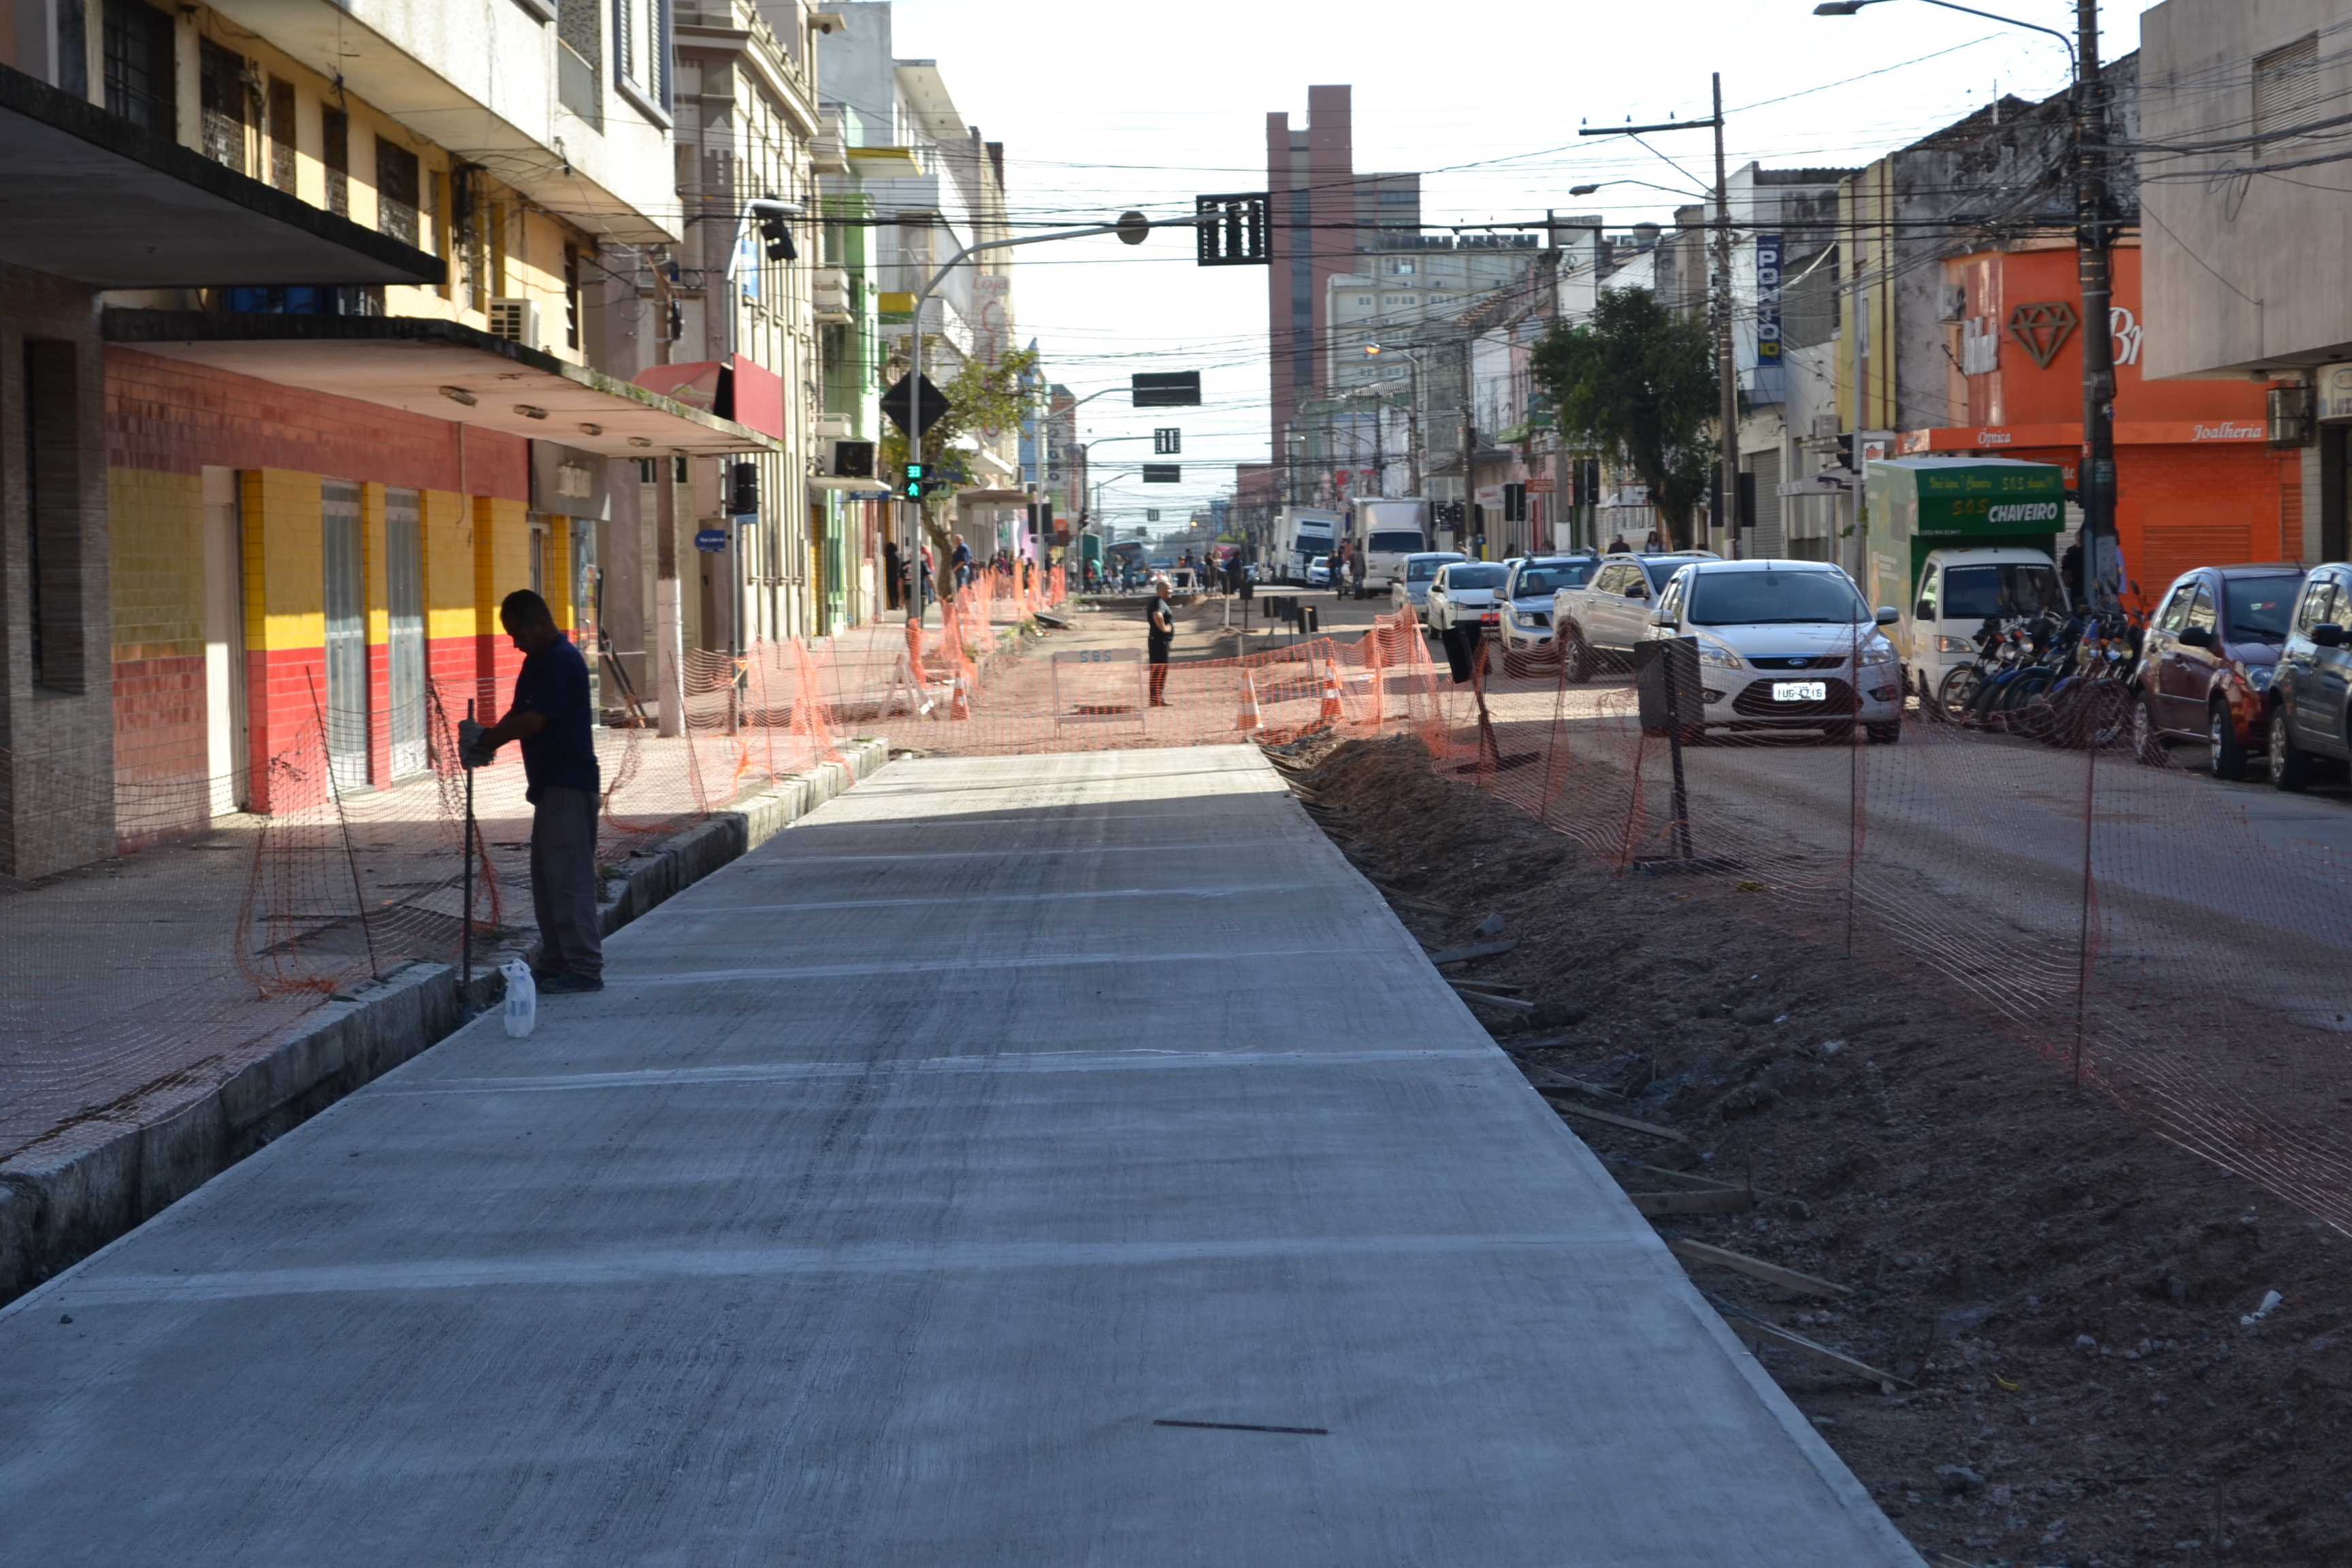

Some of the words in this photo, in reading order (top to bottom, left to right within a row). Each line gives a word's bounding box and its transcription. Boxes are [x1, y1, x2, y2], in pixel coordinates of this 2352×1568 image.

[973, 276, 1009, 294] Loja
[1759, 342, 1780, 356] 10
[1978, 427, 2012, 448] Óptica
[2191, 421, 2263, 442] Joalheria
[1988, 502, 2059, 523] CHAVEIRO
